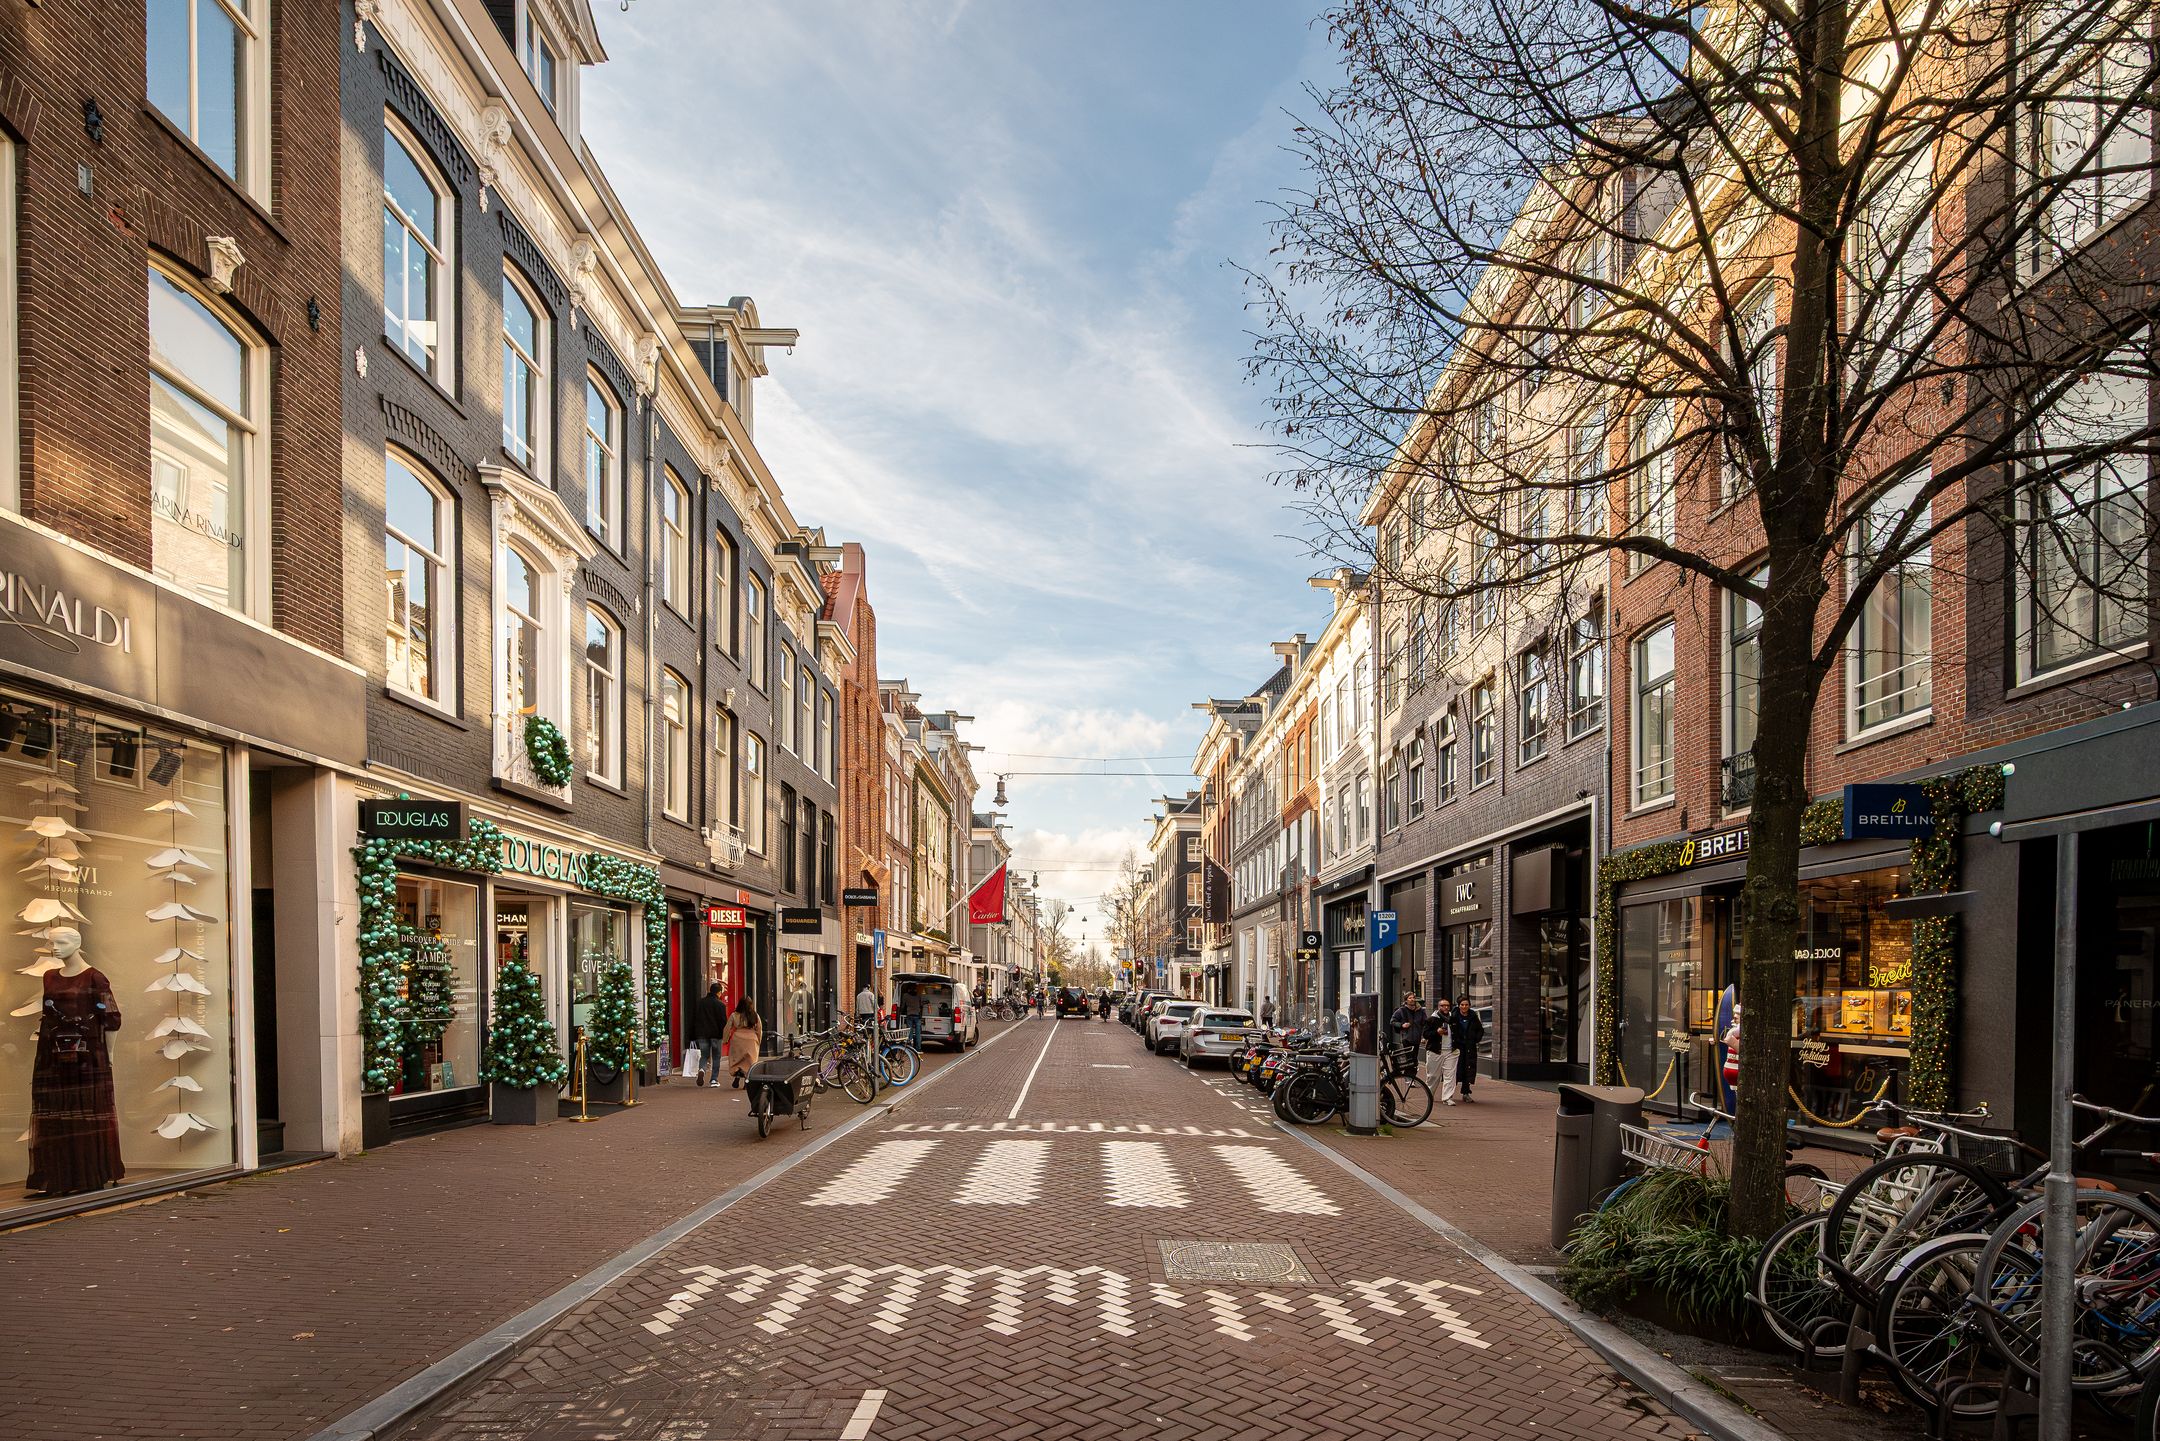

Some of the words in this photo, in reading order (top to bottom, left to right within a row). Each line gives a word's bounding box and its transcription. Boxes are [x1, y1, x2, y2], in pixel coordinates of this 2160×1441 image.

[196, 513, 243, 551] RINALDI
[376, 811, 449, 828] DOUGLAS
[500, 833, 589, 886] DOUGLAS
[1205, 864, 1213, 885] Arpels
[1456, 882, 1473, 902] IWC
[710, 909, 742, 923] DIESEL
[972, 910, 999, 920] Cartier
[1450, 903, 1479, 915] SCHAFFHAUSEN
[1378, 922, 1390, 939] P
[401, 934, 437, 945] DISCOVER
[581, 959, 602, 974] GIVE
[1803, 1038, 1829, 1052] Happy
[1799, 1050, 1830, 1062] Holidays
